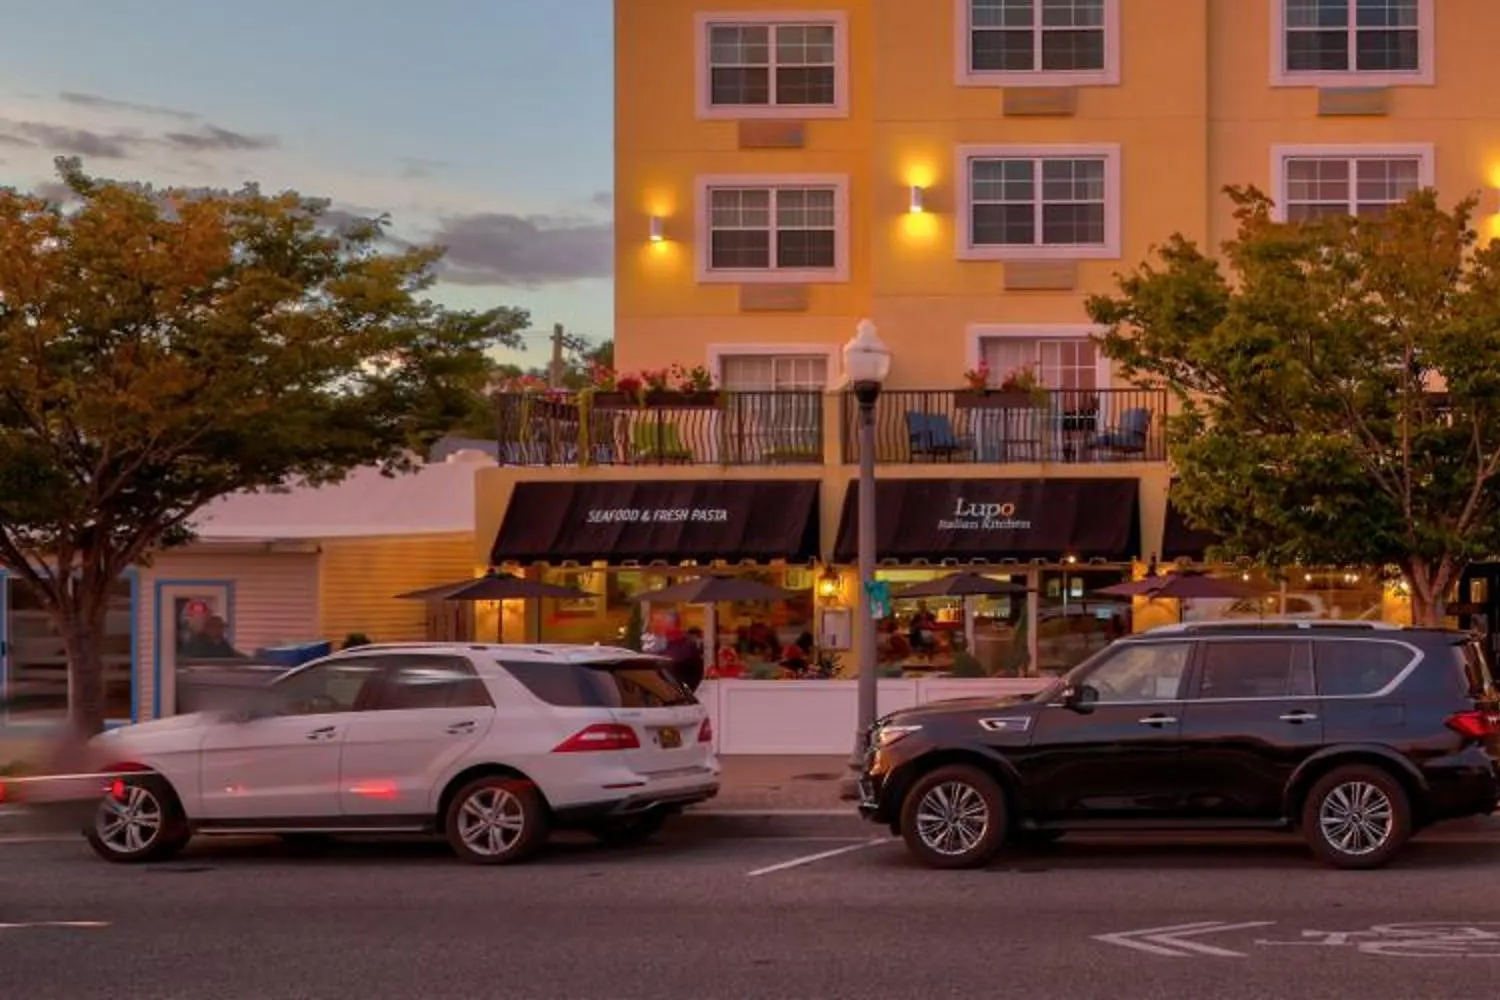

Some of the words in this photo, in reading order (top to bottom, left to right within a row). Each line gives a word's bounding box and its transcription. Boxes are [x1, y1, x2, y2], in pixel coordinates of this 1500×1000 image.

[587, 509, 639, 522] SEAFOOD
[641, 509, 650, 521] &
[653, 509, 688, 521] FRESH
[691, 509, 727, 521] PASTA
[954, 497, 1015, 521] Lupo
